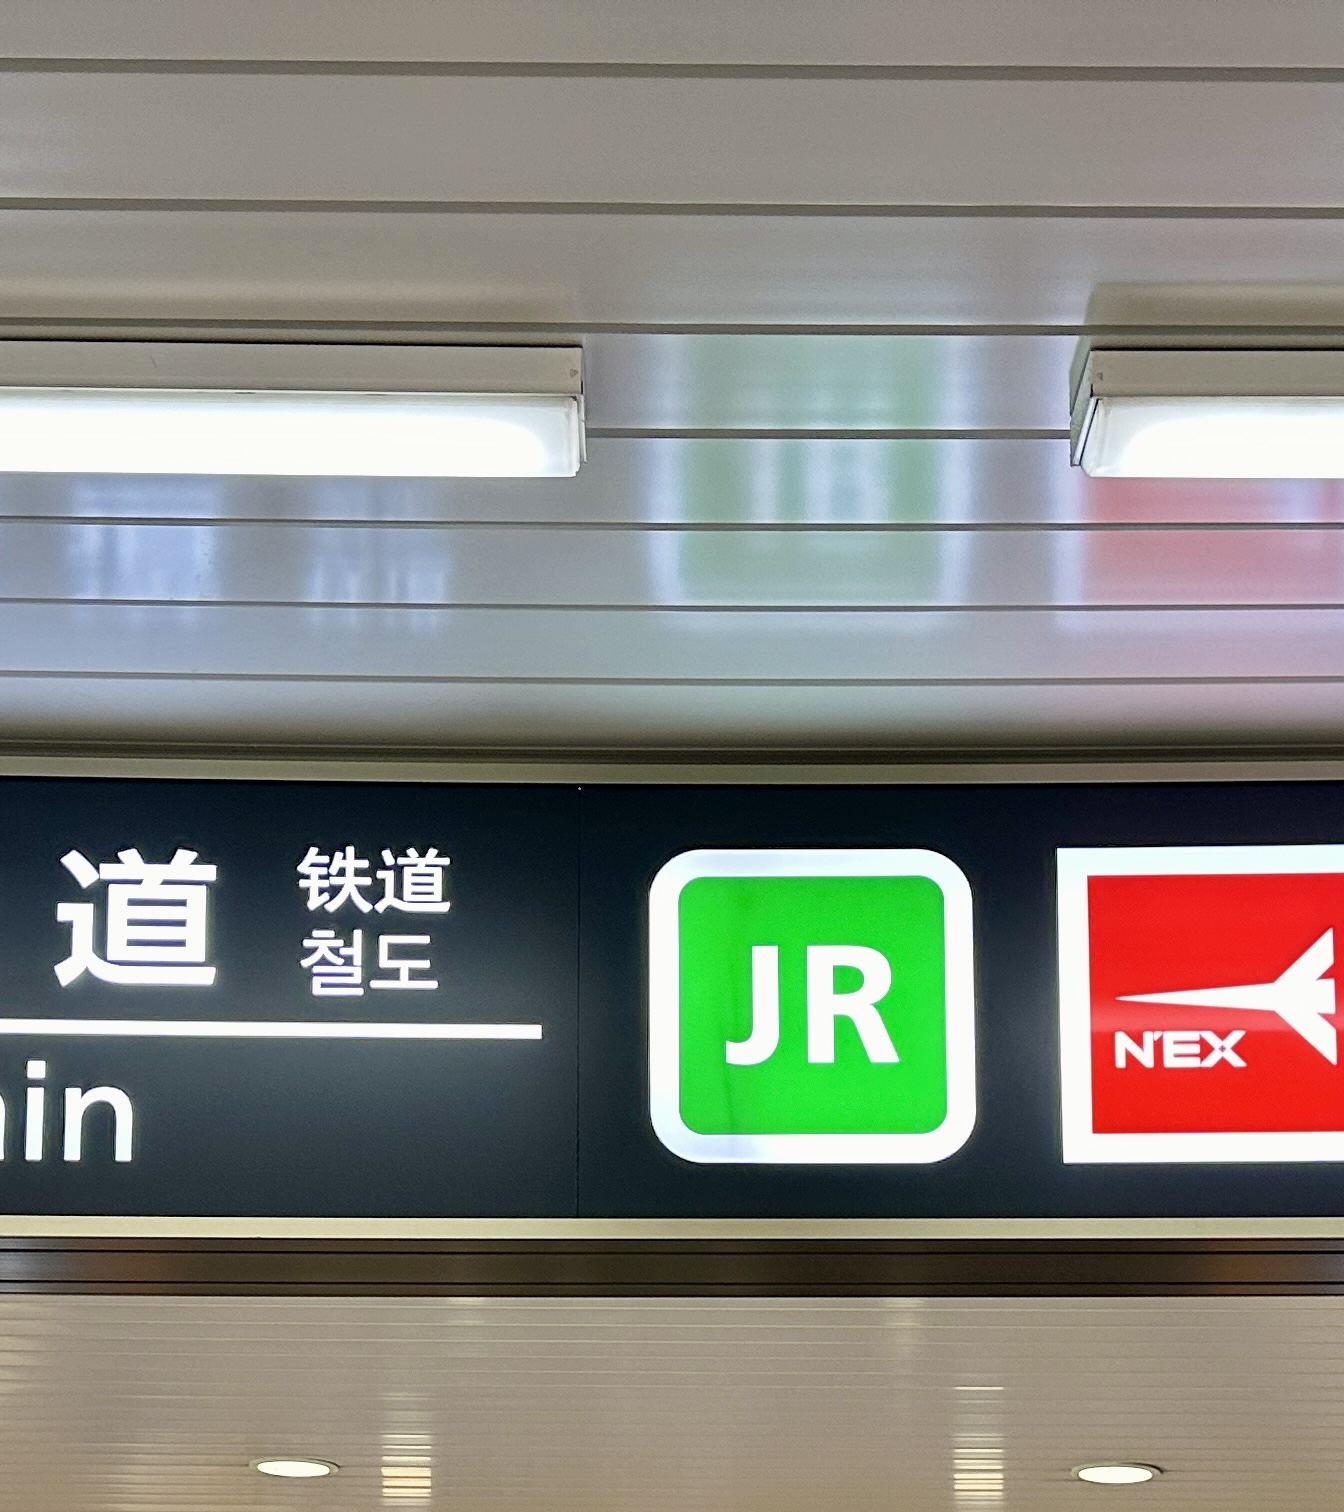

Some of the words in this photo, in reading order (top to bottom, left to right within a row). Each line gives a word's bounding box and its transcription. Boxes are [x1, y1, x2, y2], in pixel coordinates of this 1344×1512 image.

[297, 846, 450, 913] 铁道
[301, 929, 438, 996] 철도
[726, 945, 899, 1065] JR
